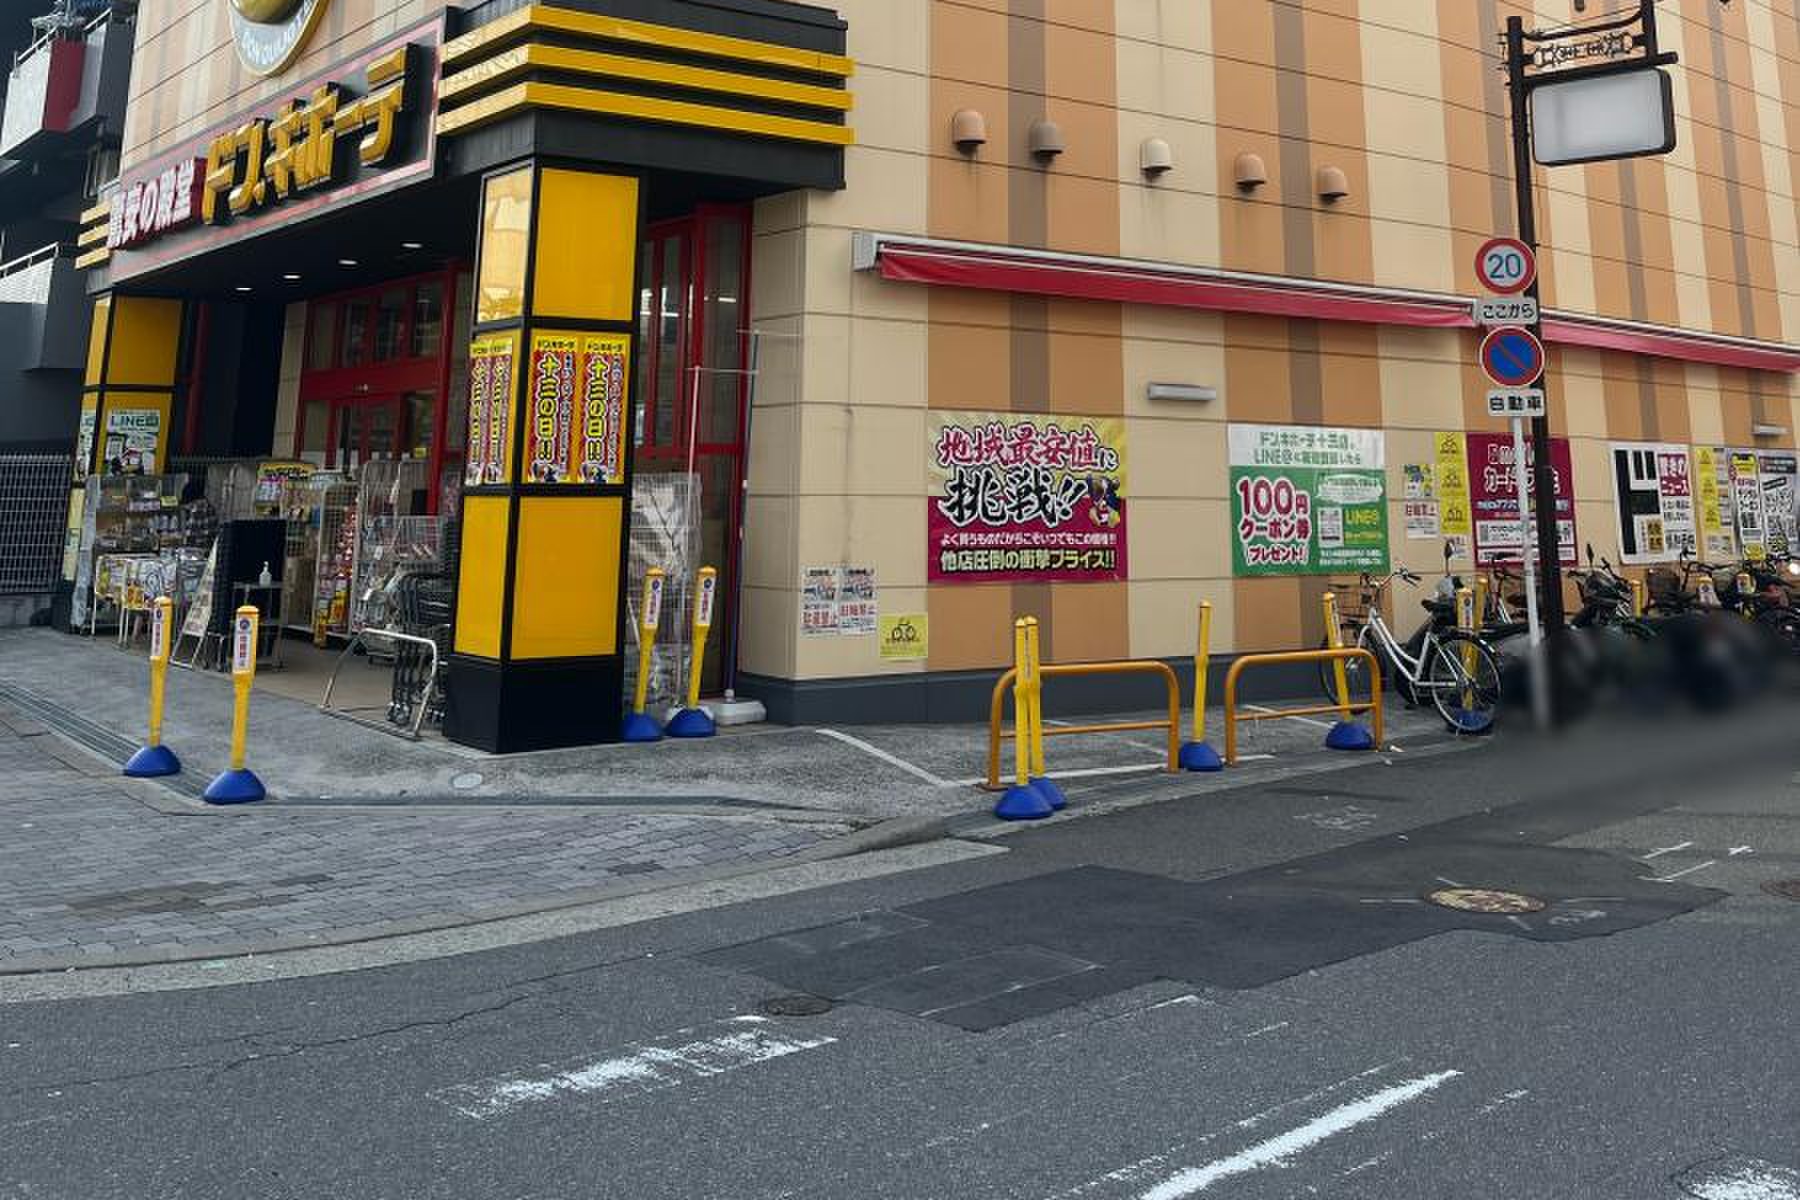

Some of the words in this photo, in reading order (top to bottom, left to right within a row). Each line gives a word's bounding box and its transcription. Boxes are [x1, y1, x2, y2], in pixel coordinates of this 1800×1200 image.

[1487, 253, 1521, 279] 20
[1482, 303, 1535, 320] ここから
[1489, 394, 1543, 412] 自動車
[935, 422, 1119, 472] 地域最安値に
[1237, 477, 1310, 518] 100円
